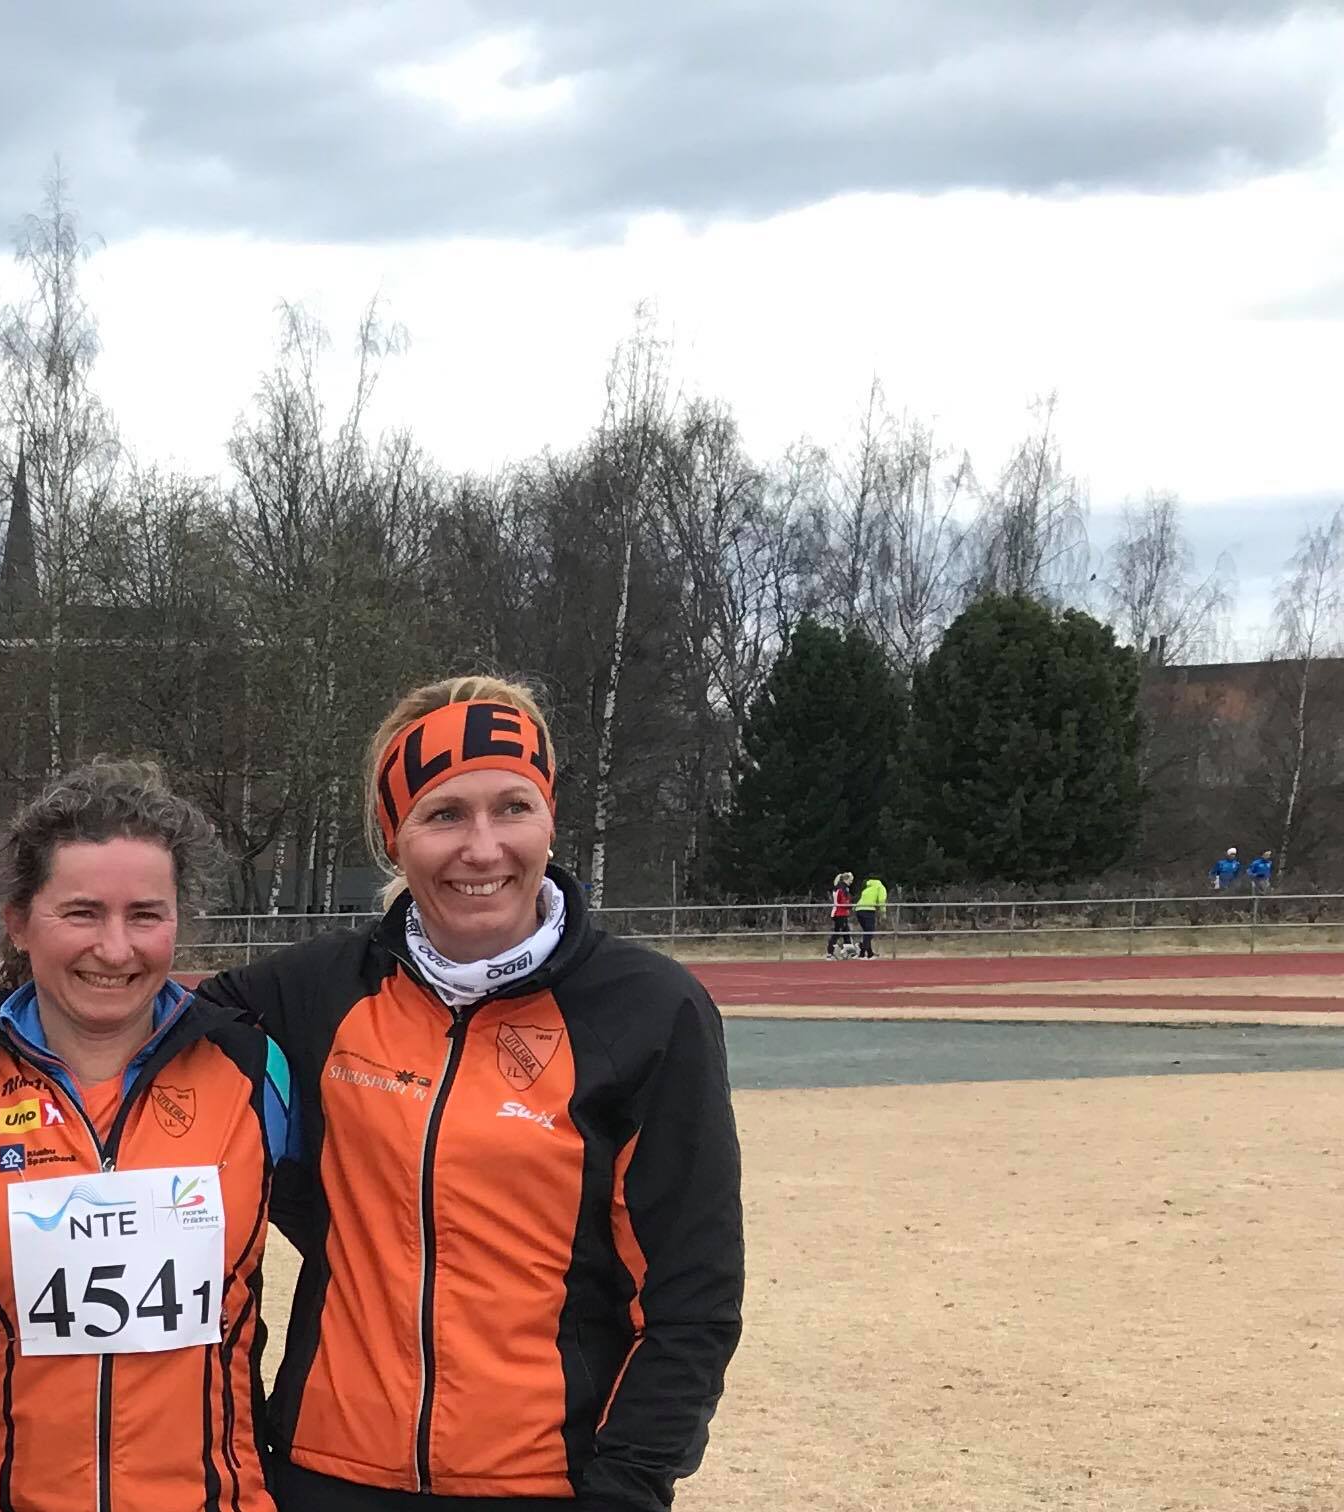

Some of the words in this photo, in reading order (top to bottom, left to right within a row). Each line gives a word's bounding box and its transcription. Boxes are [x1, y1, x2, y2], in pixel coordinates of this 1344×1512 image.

[486, 959, 528, 980] BDO
[504, 1034, 538, 1073] UTLEIRA
[5, 1110, 37, 1126] Uno
[69, 1210, 139, 1240] NTE
